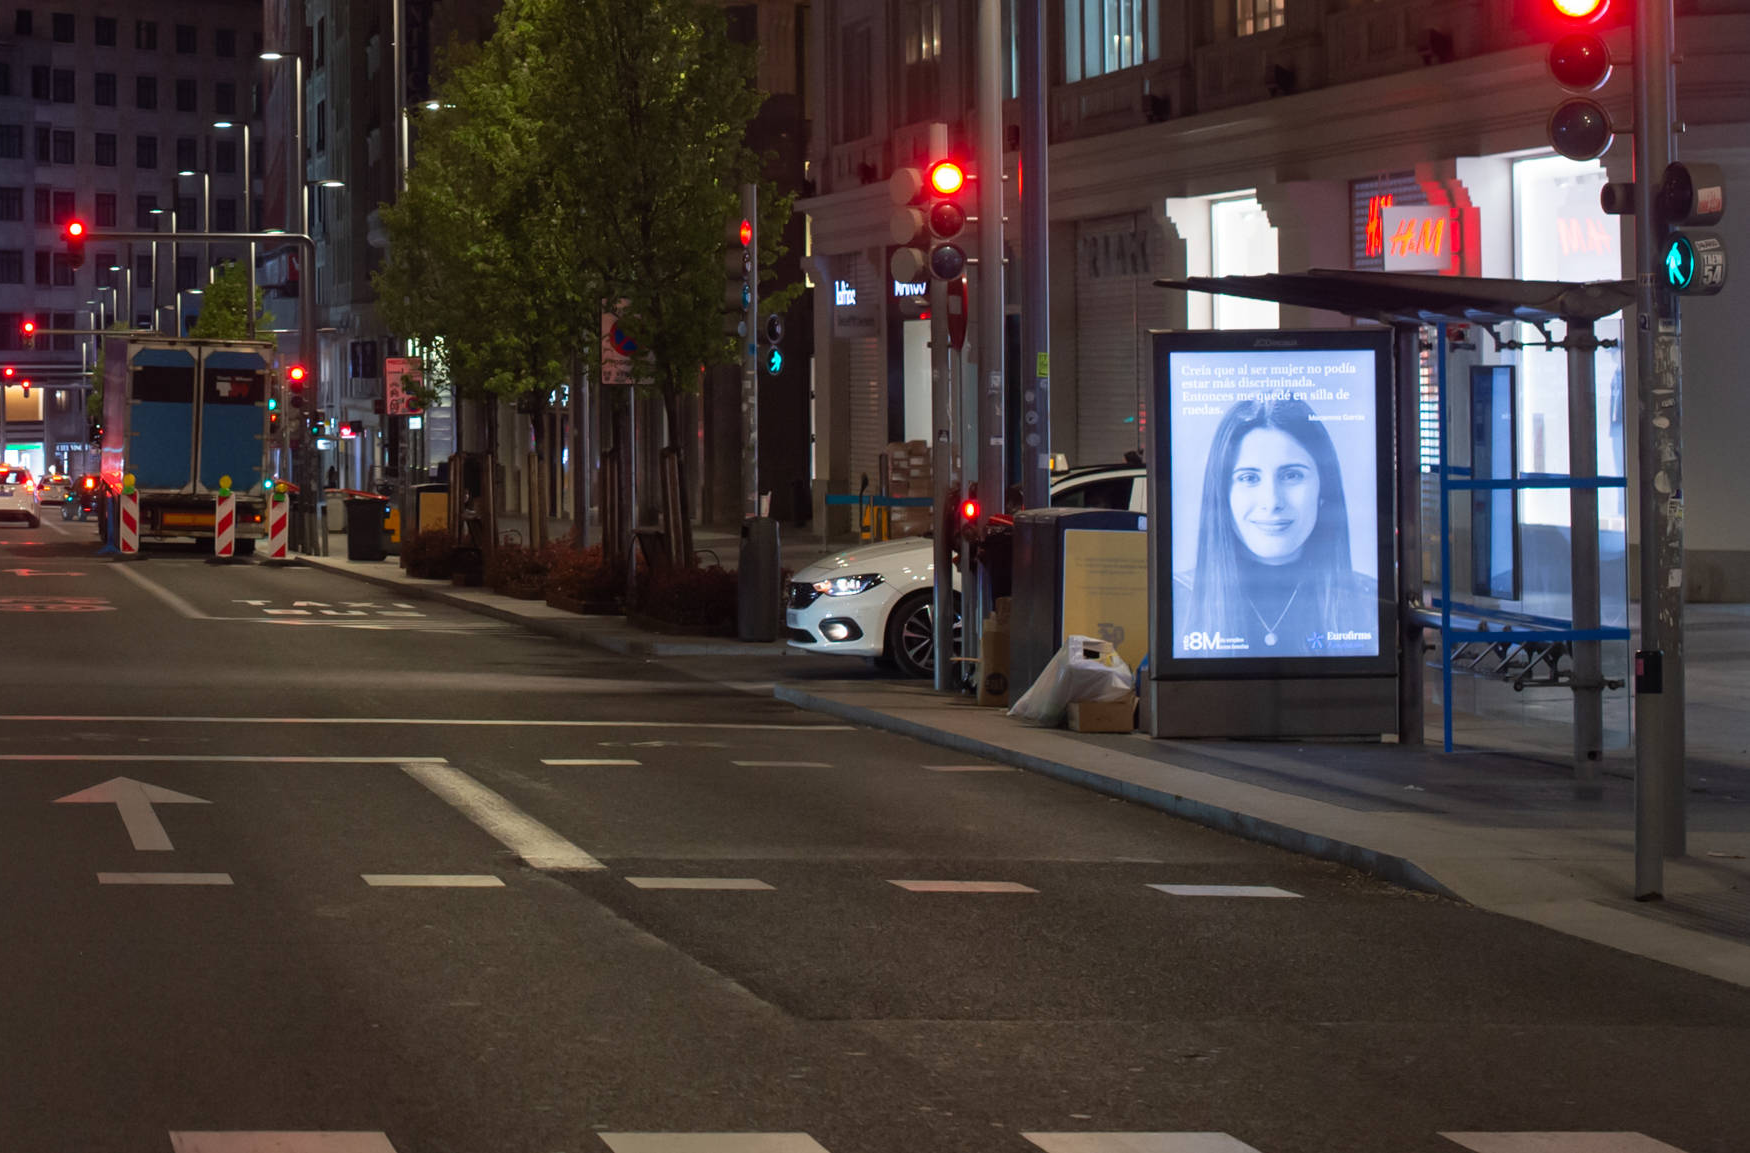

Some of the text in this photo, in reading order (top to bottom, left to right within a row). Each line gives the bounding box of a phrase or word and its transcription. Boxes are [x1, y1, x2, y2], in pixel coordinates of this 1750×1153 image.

[1390, 217, 1446, 258] H&M
[1214, 366, 1235, 377] que
[1237, 364, 1248, 375] al
[1251, 366, 1268, 375] ser
[1270, 363, 1304, 376] mujer
[1307, 365, 1321, 374] no
[1324, 362, 1356, 376] podía
[1181, 375, 1316, 389] estar más discriminada.
[1182, 389, 1350, 403] Entonces me quedé en silla de
[1182, 404, 1224, 416] ruedas.
[263, 609, 427, 617] BUS
[1326, 631, 1372, 641] Eurofirms
